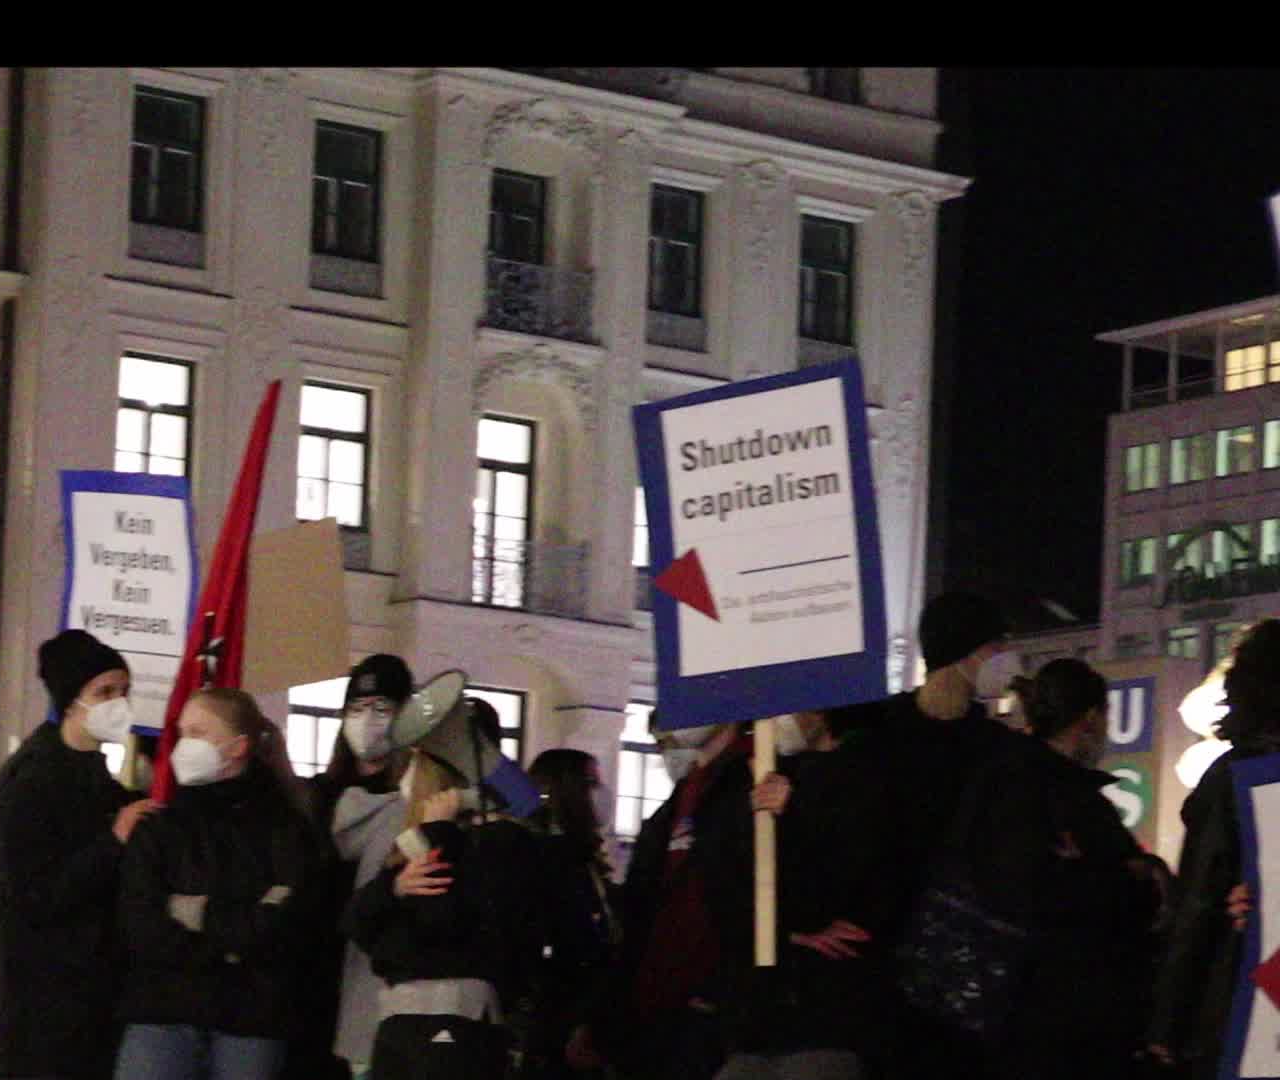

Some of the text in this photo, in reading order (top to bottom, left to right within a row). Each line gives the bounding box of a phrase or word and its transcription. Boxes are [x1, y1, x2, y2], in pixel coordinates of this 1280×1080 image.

[680, 423, 833, 472] Shutdown
[681, 471, 840, 522] capitalism
[115, 511, 153, 535] Kein
[113, 579, 152, 602] Kein
[1107, 686, 1145, 744] U
